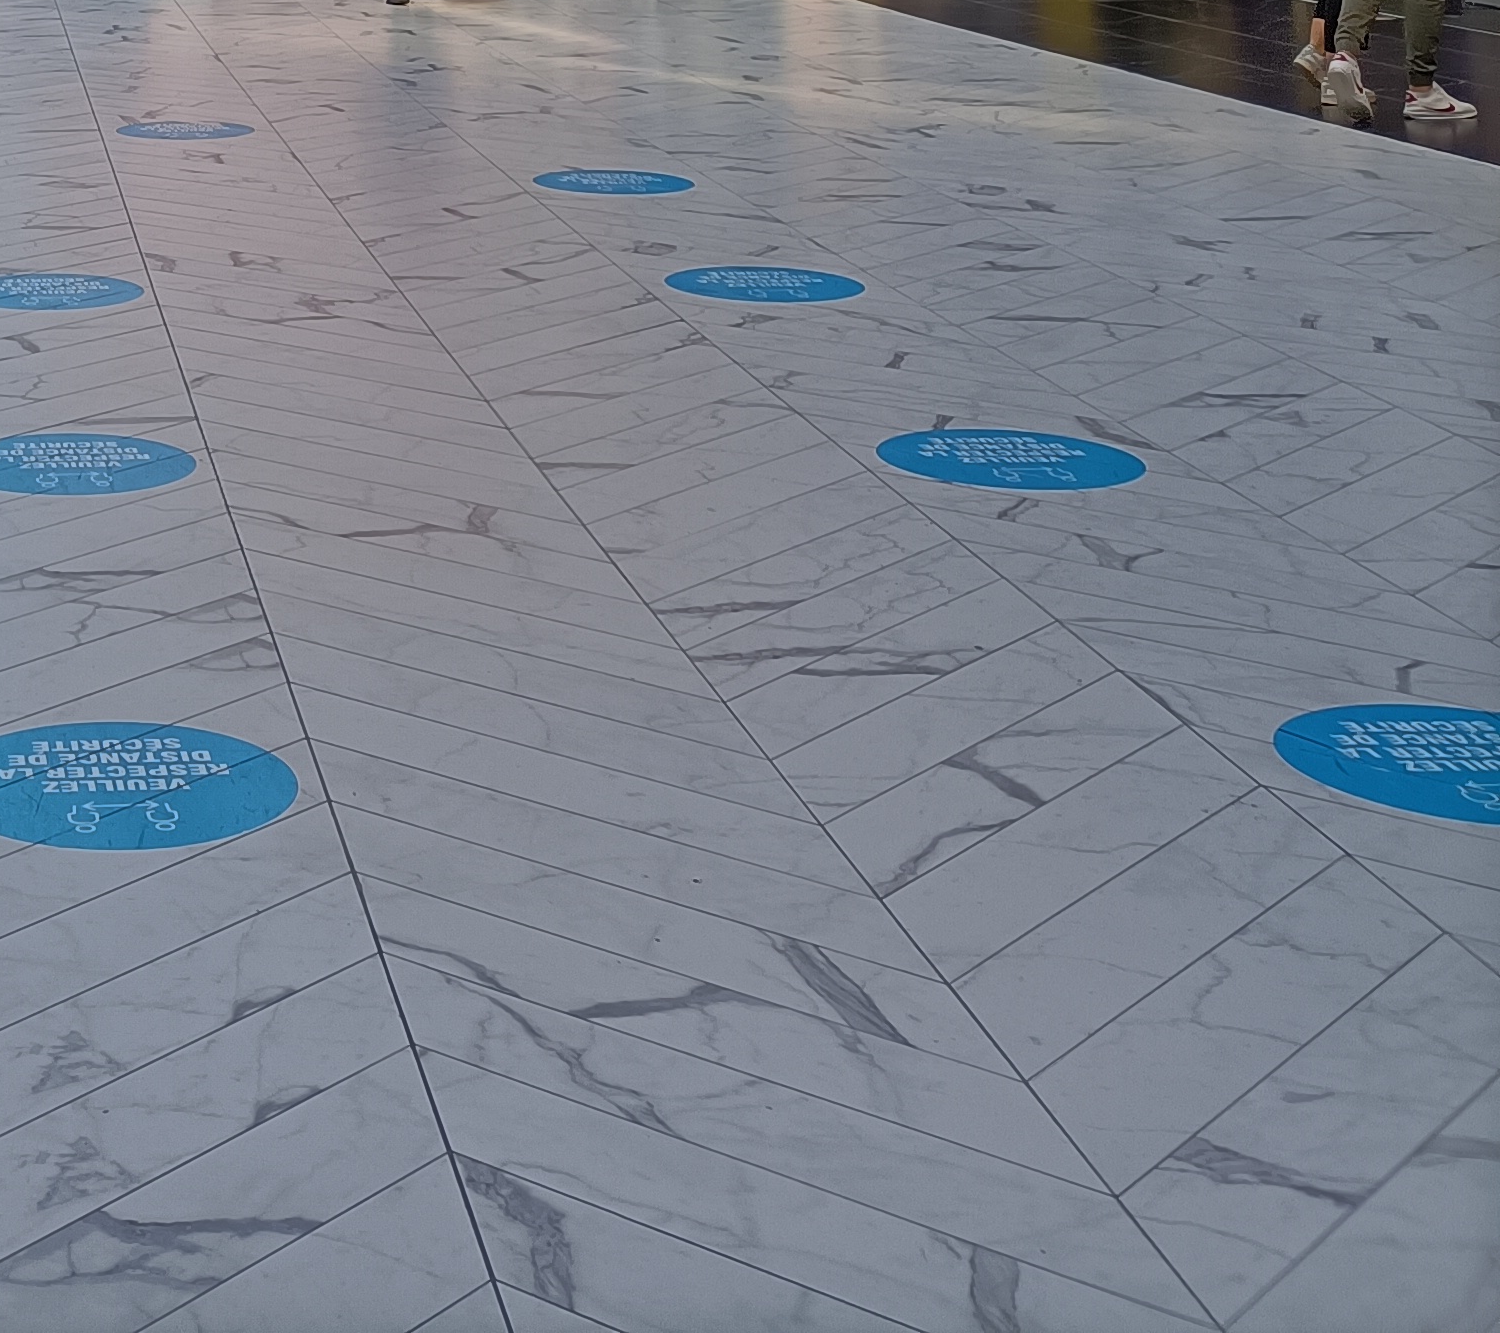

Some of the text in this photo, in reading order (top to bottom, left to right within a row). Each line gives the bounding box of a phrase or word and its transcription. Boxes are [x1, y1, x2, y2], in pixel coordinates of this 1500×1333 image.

[32, 447, 139, 455] DISTANCE
[21, 453, 151, 462] RESPECTER
[19, 461, 122, 469] VEUILLEZ
[31, 738, 181, 754] SÉCURITÉ
[1329, 734, 1380, 746] DE
[7, 750, 212, 766] DISTANCE DE
[1334, 747, 1383, 759] LA
[46, 763, 231, 779] RESPECTER
[41, 777, 191, 793] VEUILLEZ
